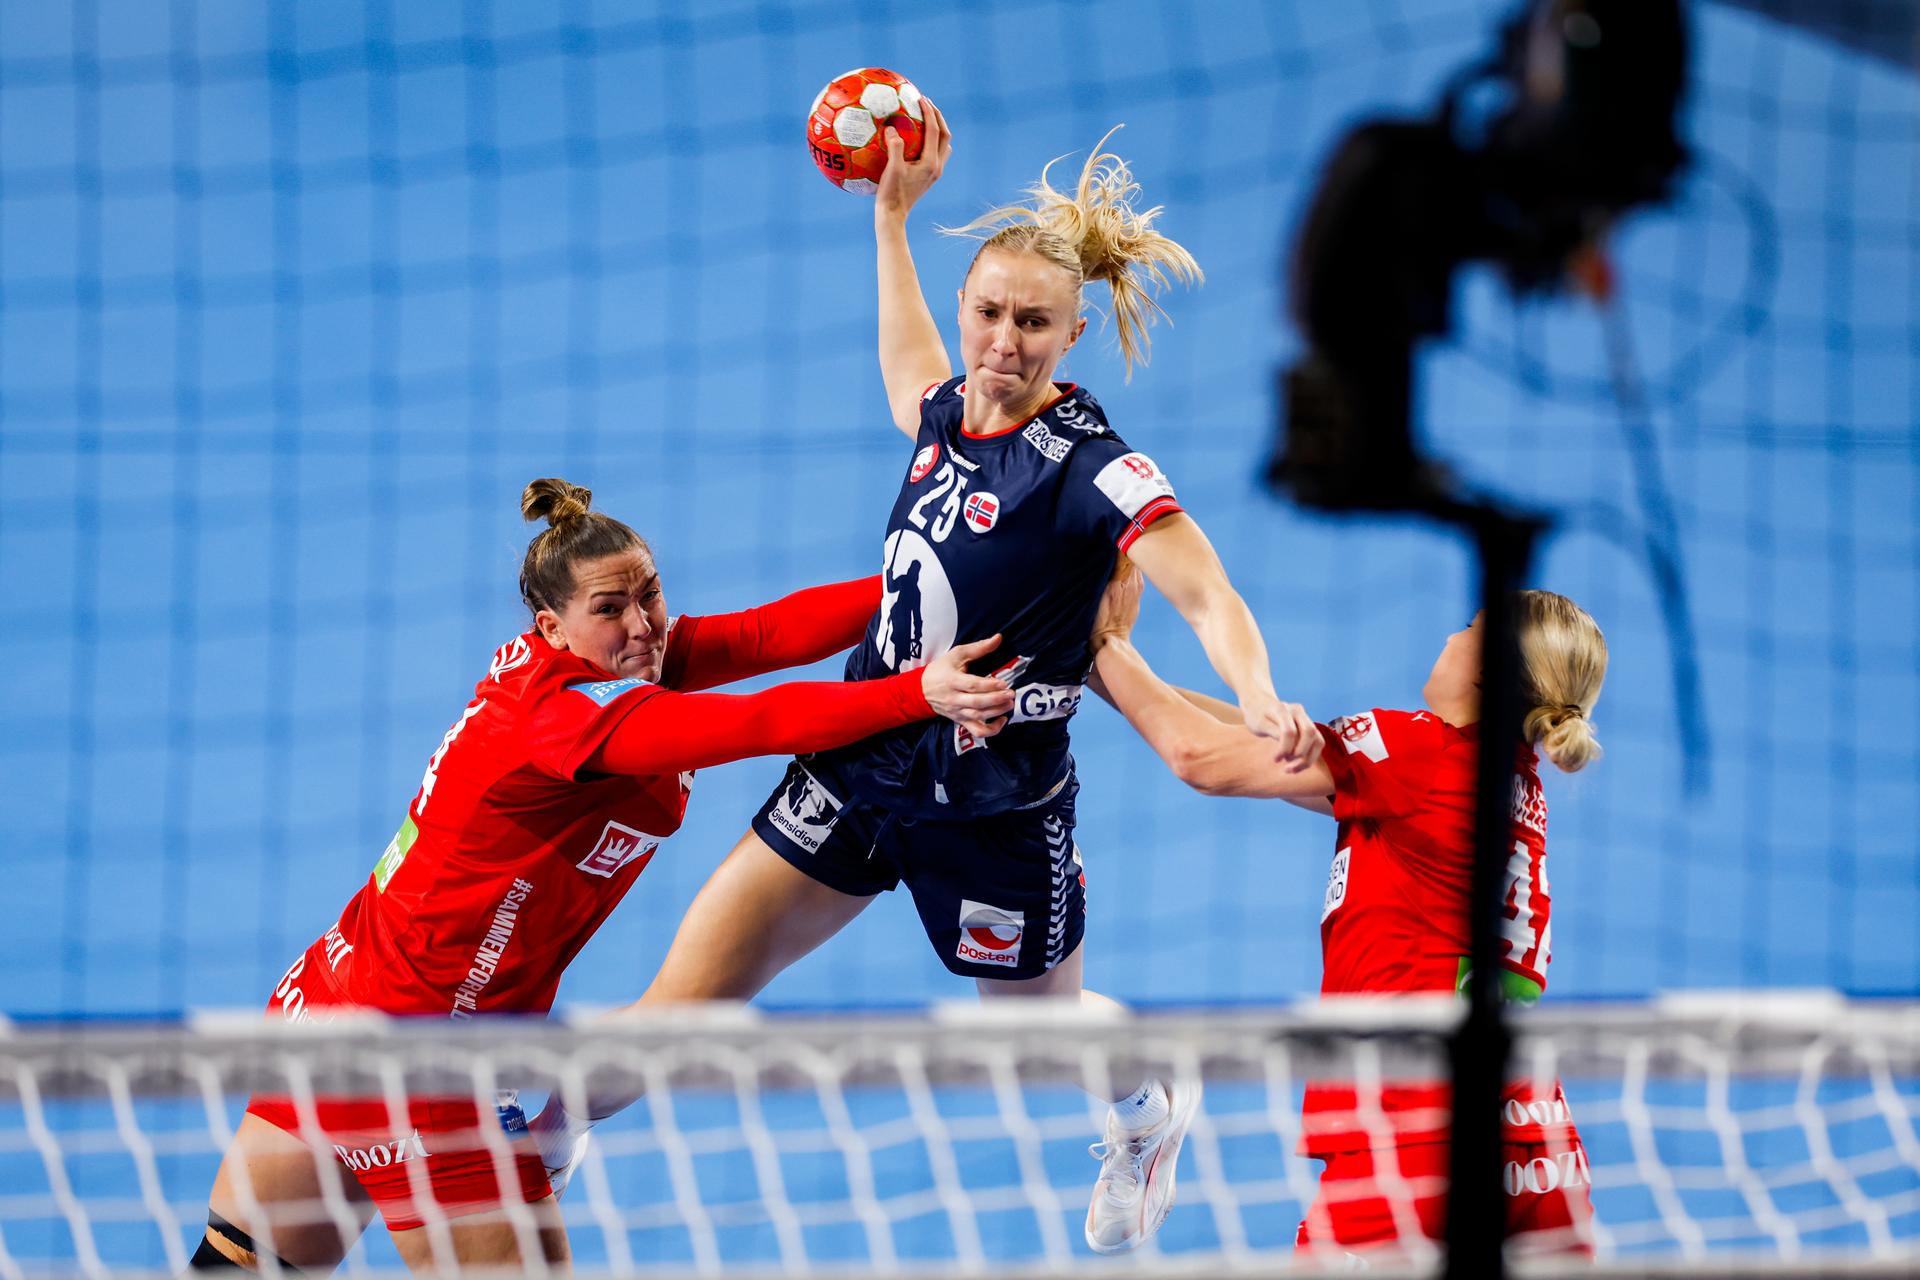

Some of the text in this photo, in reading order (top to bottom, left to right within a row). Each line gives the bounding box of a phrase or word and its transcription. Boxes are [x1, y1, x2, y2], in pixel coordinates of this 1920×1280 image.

[810, 143, 845, 171] SEL
[907, 462, 968, 543] 25
[770, 807, 819, 850] Gjensidige
[958, 942, 1016, 963] posten
